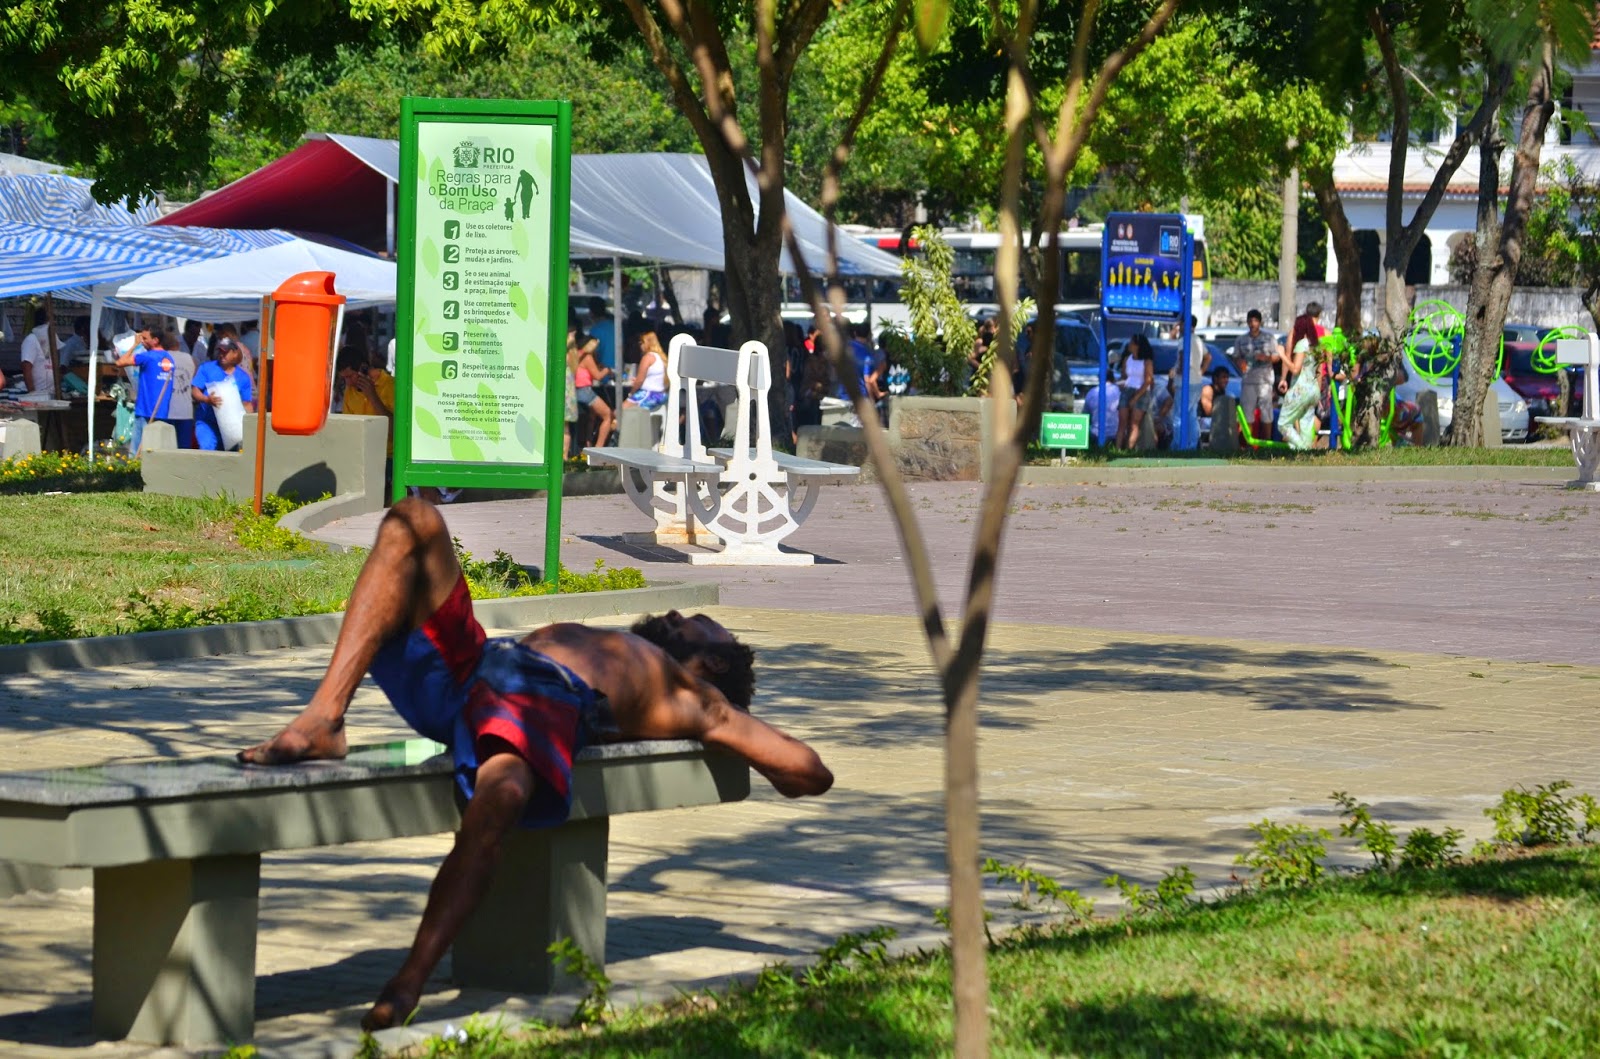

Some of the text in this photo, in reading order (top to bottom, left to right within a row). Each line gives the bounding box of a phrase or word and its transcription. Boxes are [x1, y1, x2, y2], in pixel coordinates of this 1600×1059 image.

[483, 147, 514, 163] RIO
[436, 170, 511, 186] Regras para
[429, 184, 497, 198] o Bom Uso
[440, 197, 494, 214] da Praça
[450, 226, 458, 240] 1
[1169, 235, 1178, 247] RIO
[448, 246, 459, 260] 2
[444, 274, 455, 289] 3
[444, 303, 455, 318] 4
[442, 333, 453, 348] 5
[445, 364, 456, 379] 6
